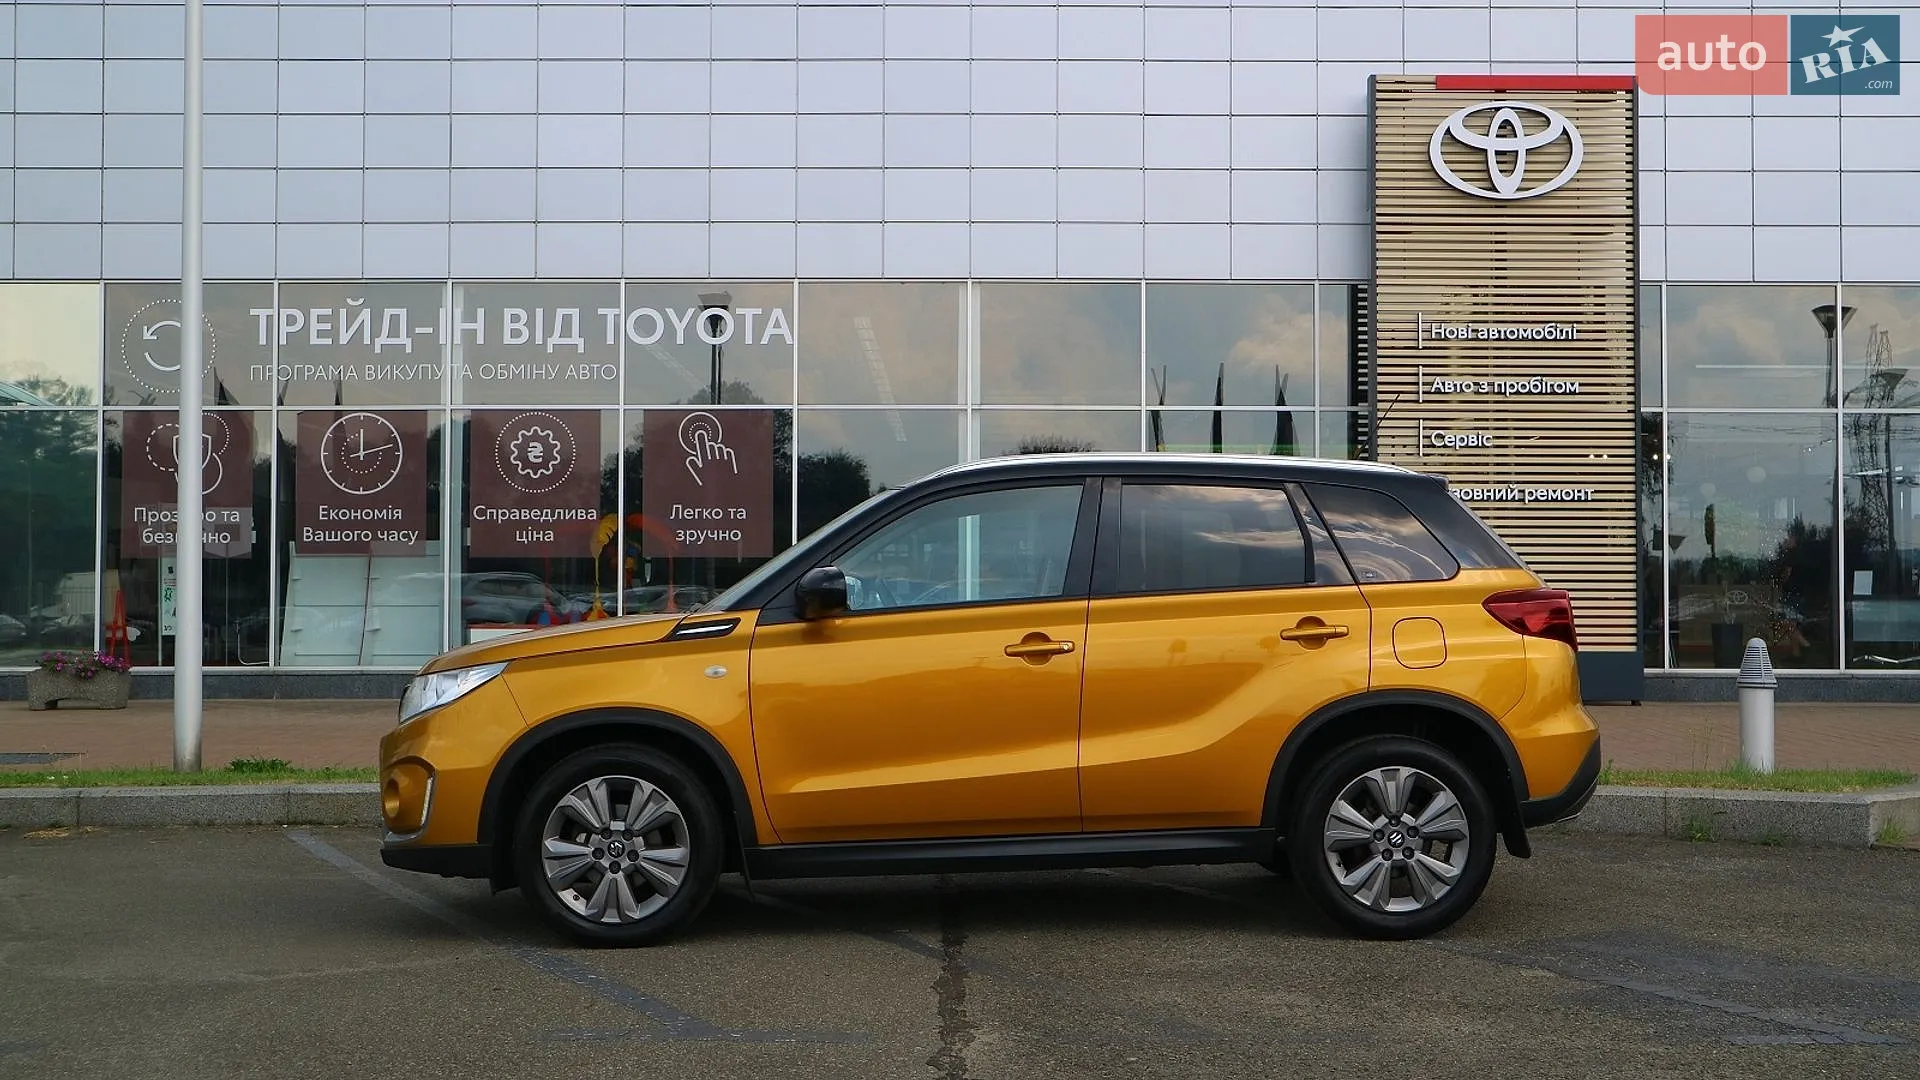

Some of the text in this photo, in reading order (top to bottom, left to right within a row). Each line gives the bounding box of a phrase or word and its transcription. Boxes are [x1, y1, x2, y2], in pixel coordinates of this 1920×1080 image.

[503, 308, 585, 353] ВІД
[1431, 323, 1577, 340] Нові автомобілі
[250, 364, 359, 381] ПРОГРАМА
[365, 364, 444, 381] ВИКУПУ
[480, 363, 560, 380] ОБМІНУ
[565, 363, 617, 380] АВТО
[1431, 376, 1474, 393] Авто
[1494, 375, 1580, 397] пробігом
[1431, 431, 1493, 450] Сервіс
[1449, 483, 1594, 504] зовний ремонт
[134, 507, 240, 526] Прозо та
[319, 505, 402, 520] Економія
[473, 505, 597, 522] Справедлива
[670, 504, 746, 520] Легко та
[142, 528, 231, 544] безчно
[303, 527, 418, 545] Вашого часу
[515, 525, 555, 544] ціна
[676, 529, 741, 544] зручно
